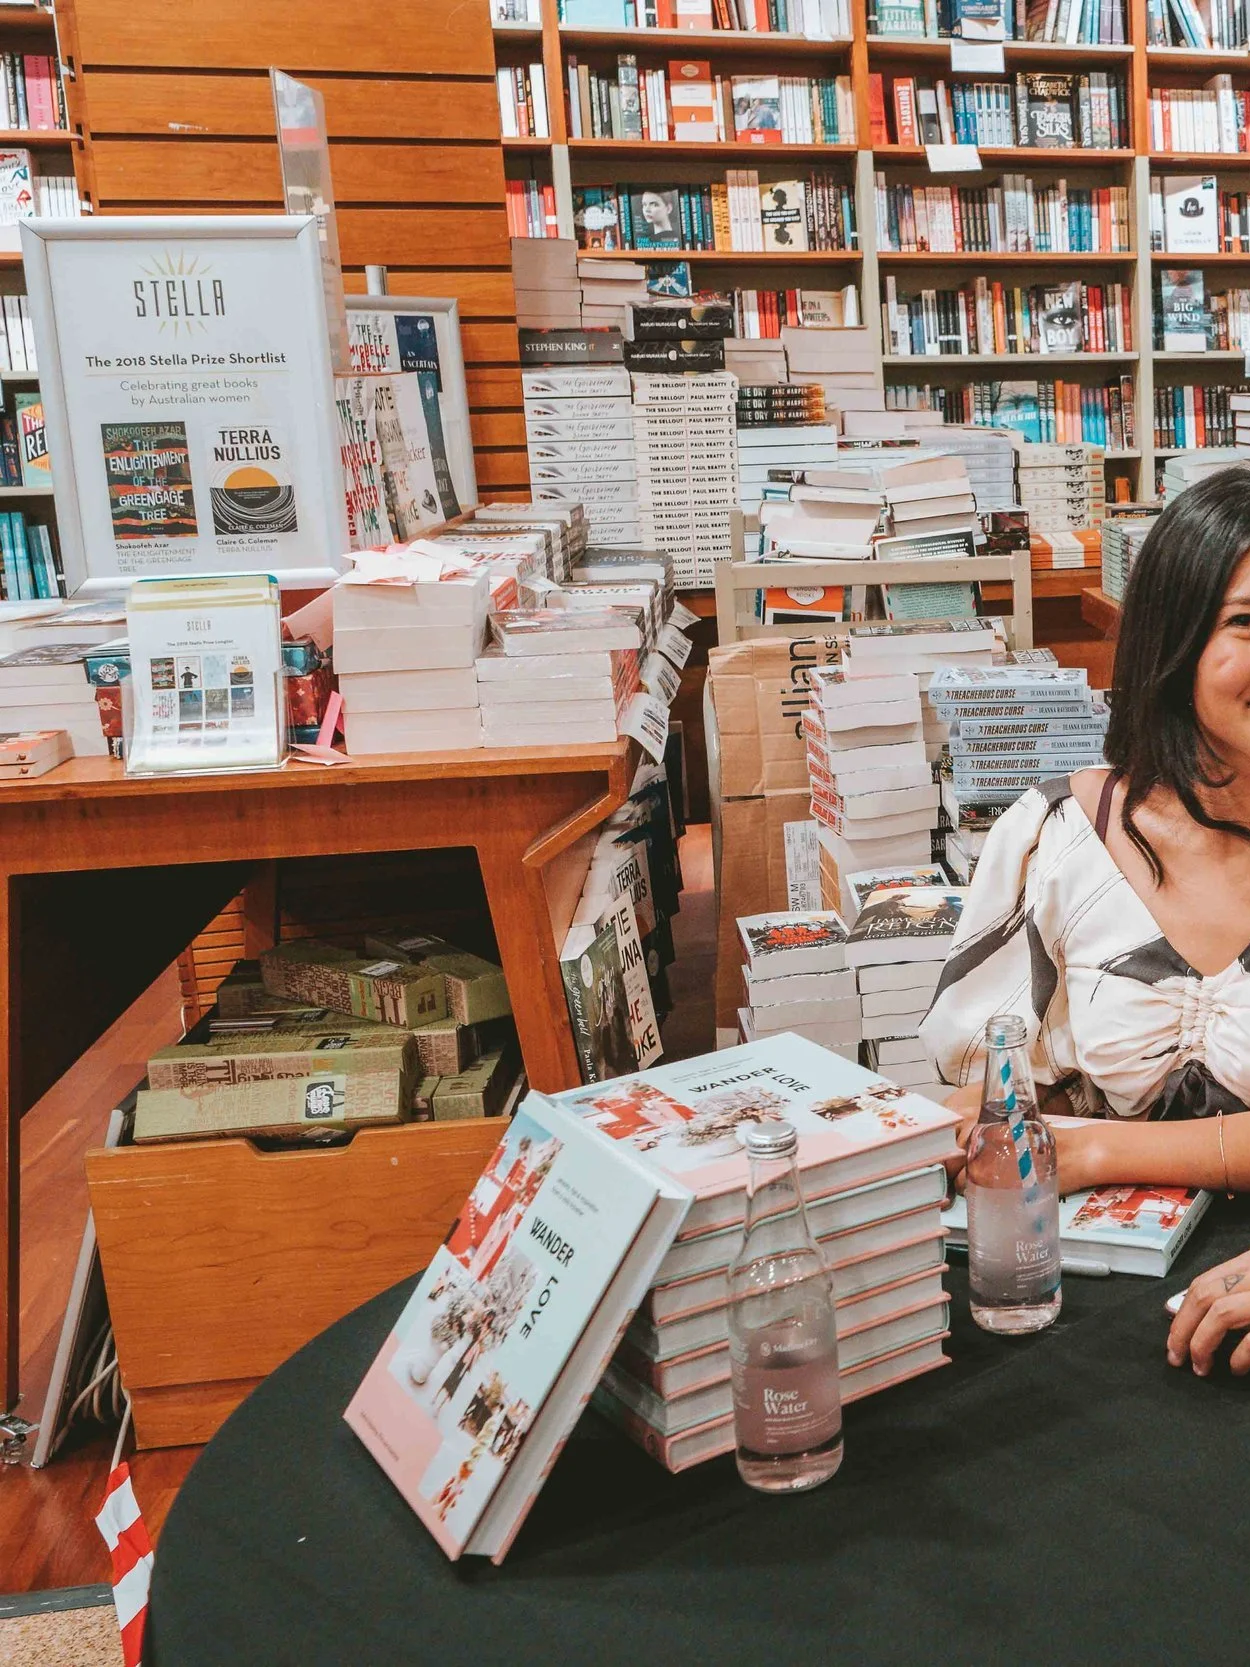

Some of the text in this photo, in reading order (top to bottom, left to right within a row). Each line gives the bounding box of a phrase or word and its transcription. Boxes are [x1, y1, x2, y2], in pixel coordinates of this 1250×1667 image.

[134, 280, 225, 317] STELLA
[1045, 292, 1073, 309] NEW
[1173, 302, 1193, 312] BIG
[1167, 312, 1201, 322] WIND
[1047, 329, 1074, 345] BOY
[525, 343, 587, 352] STEPHEN KING
[86, 352, 286, 368] The 2018 Stella Prize Shortlist
[120, 378, 258, 392] Celebrating great books
[131, 394, 250, 407] by Australian women
[218, 430, 272, 445] TERRA
[214, 446, 281, 461] NULLIUS
[110, 453, 186, 471] ENLIGHTENMENT
[119, 491, 185, 506] GREENGAGE
[139, 510, 168, 521] TREE
[959, 708, 1002, 717] TREACHEROUS
[1003, 706, 1025, 716] CURSE
[983, 723, 1048, 735] TREACHEROUS CURSE
[617, 858, 641, 893] TERRA
[863, 932, 906, 940] MORGAN
[570, 986, 582, 1021] green
[688, 1066, 776, 1093] WANDER
[771, 1073, 811, 1093] LOVE
[530, 1217, 575, 1267] WANDER
[1015, 1240, 1043, 1252] Rose
[1015, 1249, 1049, 1263] Water
[520, 1276, 558, 1339] LOVE
[764, 1388, 799, 1403] Rose
[764, 1401, 808, 1415] Water
